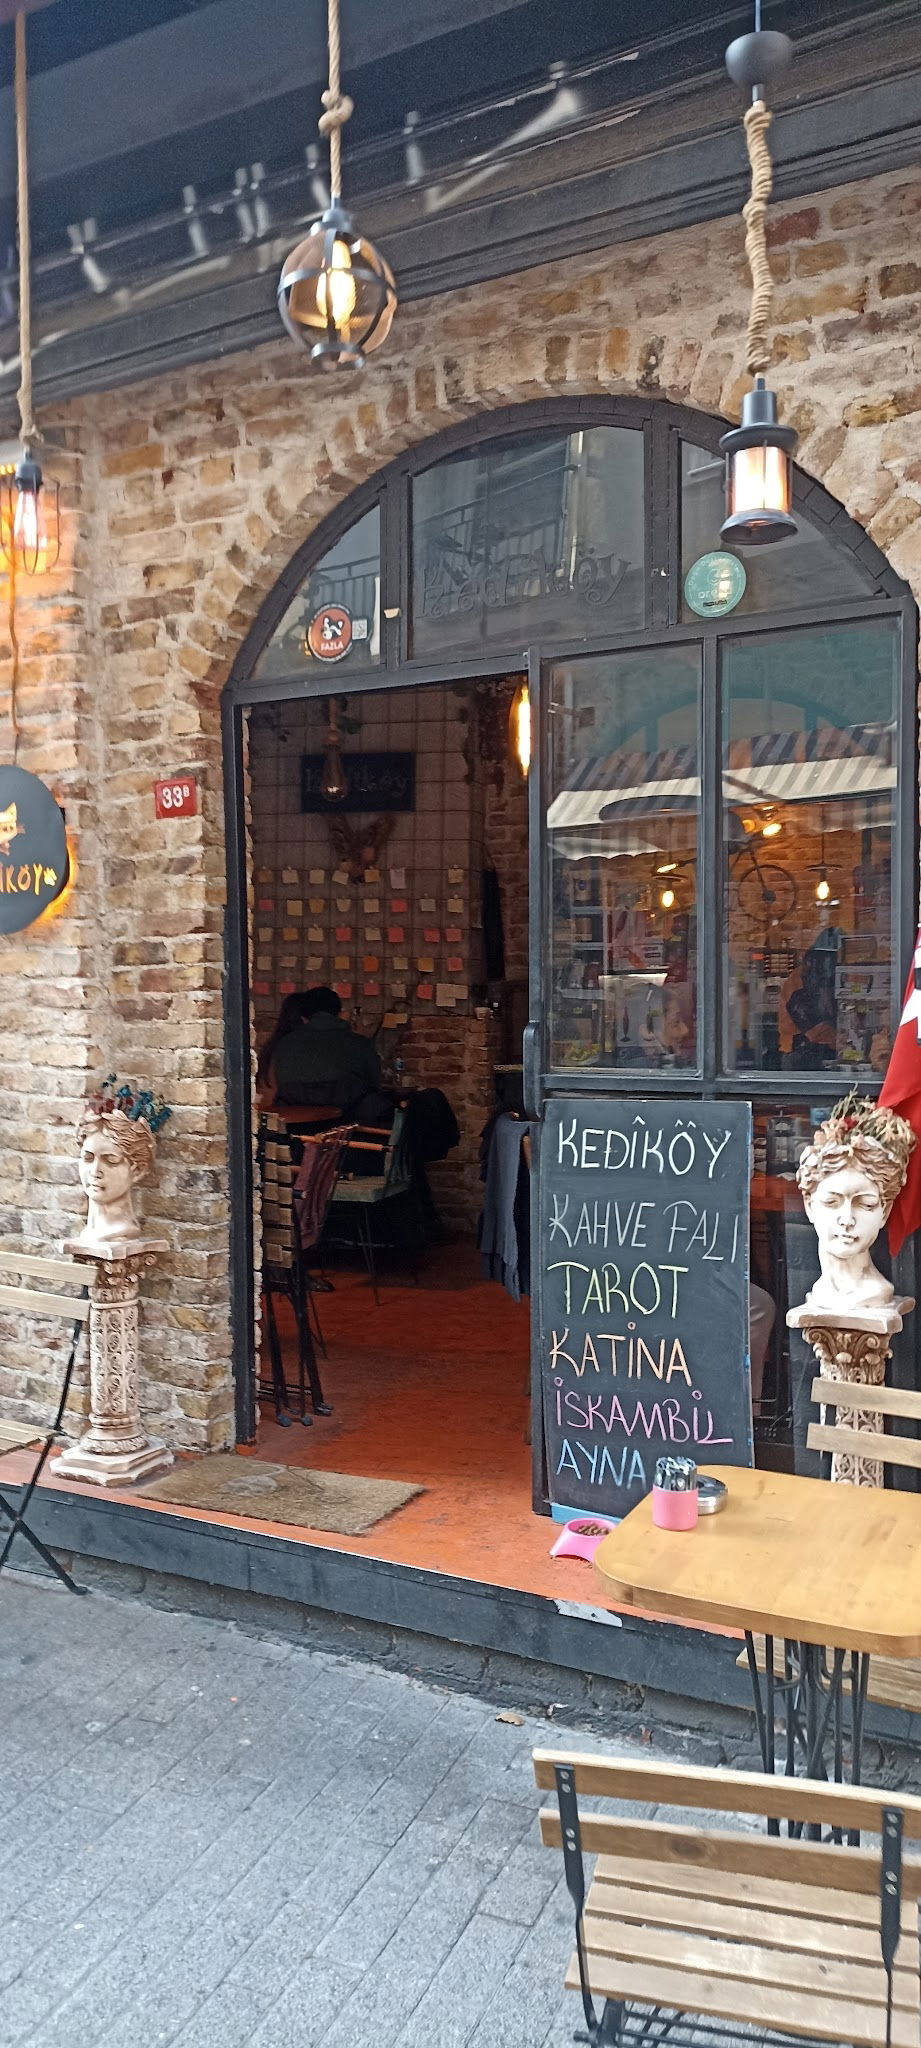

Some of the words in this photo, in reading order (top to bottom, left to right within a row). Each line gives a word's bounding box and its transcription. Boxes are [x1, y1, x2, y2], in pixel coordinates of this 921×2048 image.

[549, 1194, 656, 1248] KAHVE
[663, 1200, 739, 1264] FALI
[546, 1261, 689, 1319] TAROT
[549, 1321, 692, 1387] KATİNA
[553, 1376, 733, 1444] İSKAMBİL
[556, 1438, 648, 1490] AYNA
